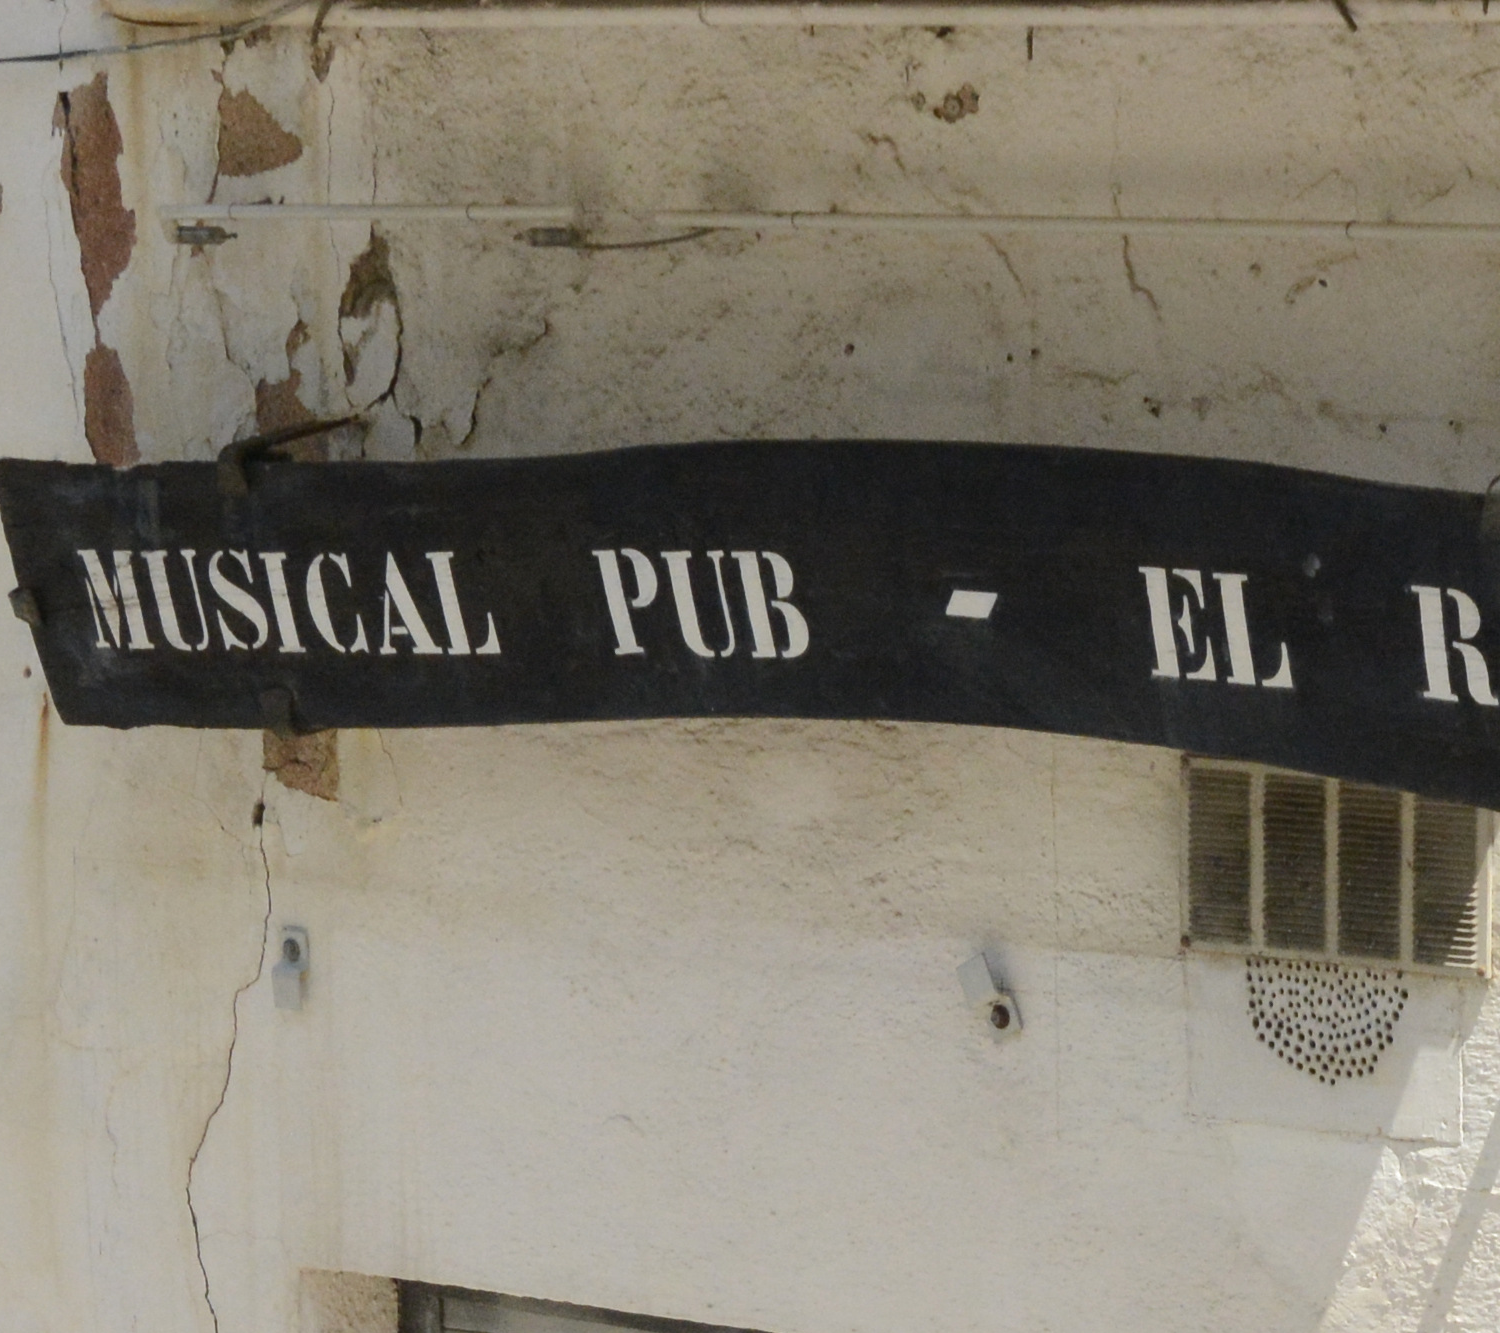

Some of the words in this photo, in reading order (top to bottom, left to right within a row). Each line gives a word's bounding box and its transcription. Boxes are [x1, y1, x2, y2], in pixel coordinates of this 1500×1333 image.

[77, 549, 501, 655] MUSICAL
[591, 548, 810, 659] PUB
[1137, 565, 1294, 689] EL
